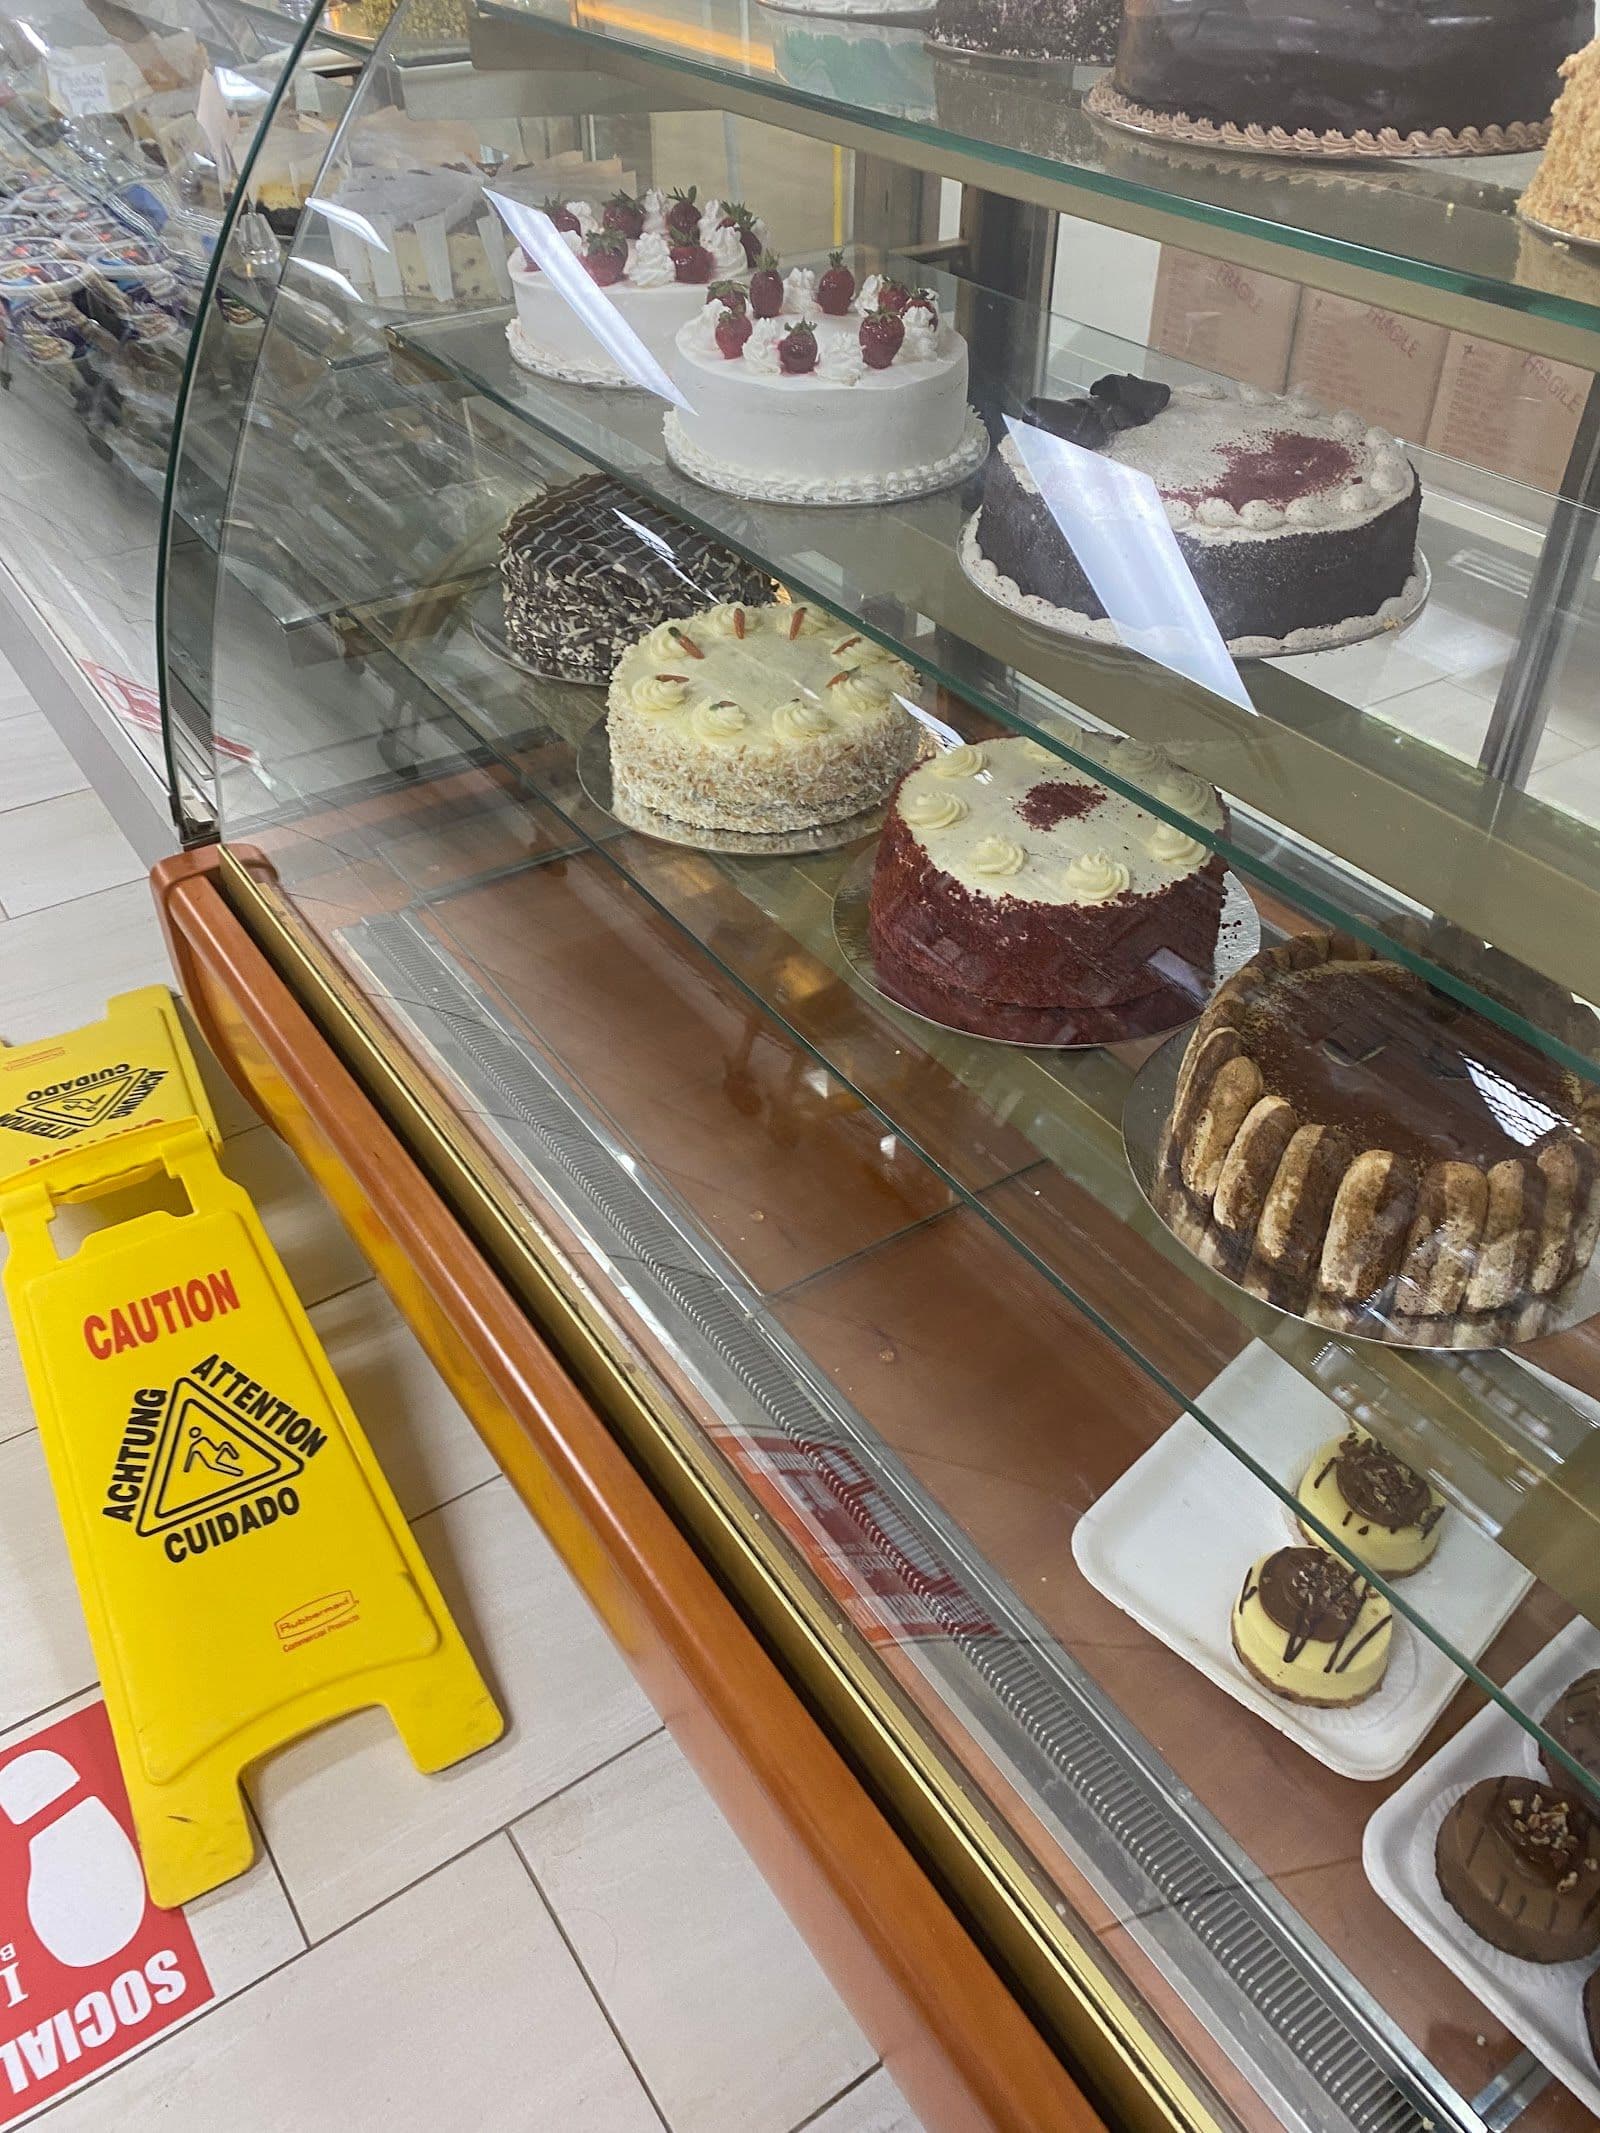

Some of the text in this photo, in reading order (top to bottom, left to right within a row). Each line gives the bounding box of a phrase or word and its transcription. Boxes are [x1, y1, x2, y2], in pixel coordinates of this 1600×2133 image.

[26, 1063, 130, 1101] CUIDADO
[83, 1268, 241, 1361] CAUTION
[190, 1353, 328, 1458] ATTENTION
[102, 1388, 168, 1523] ACHTUNG
[164, 1486, 300, 1564] CUIDADO
[0, 1949, 187, 2094] SOCIAL
